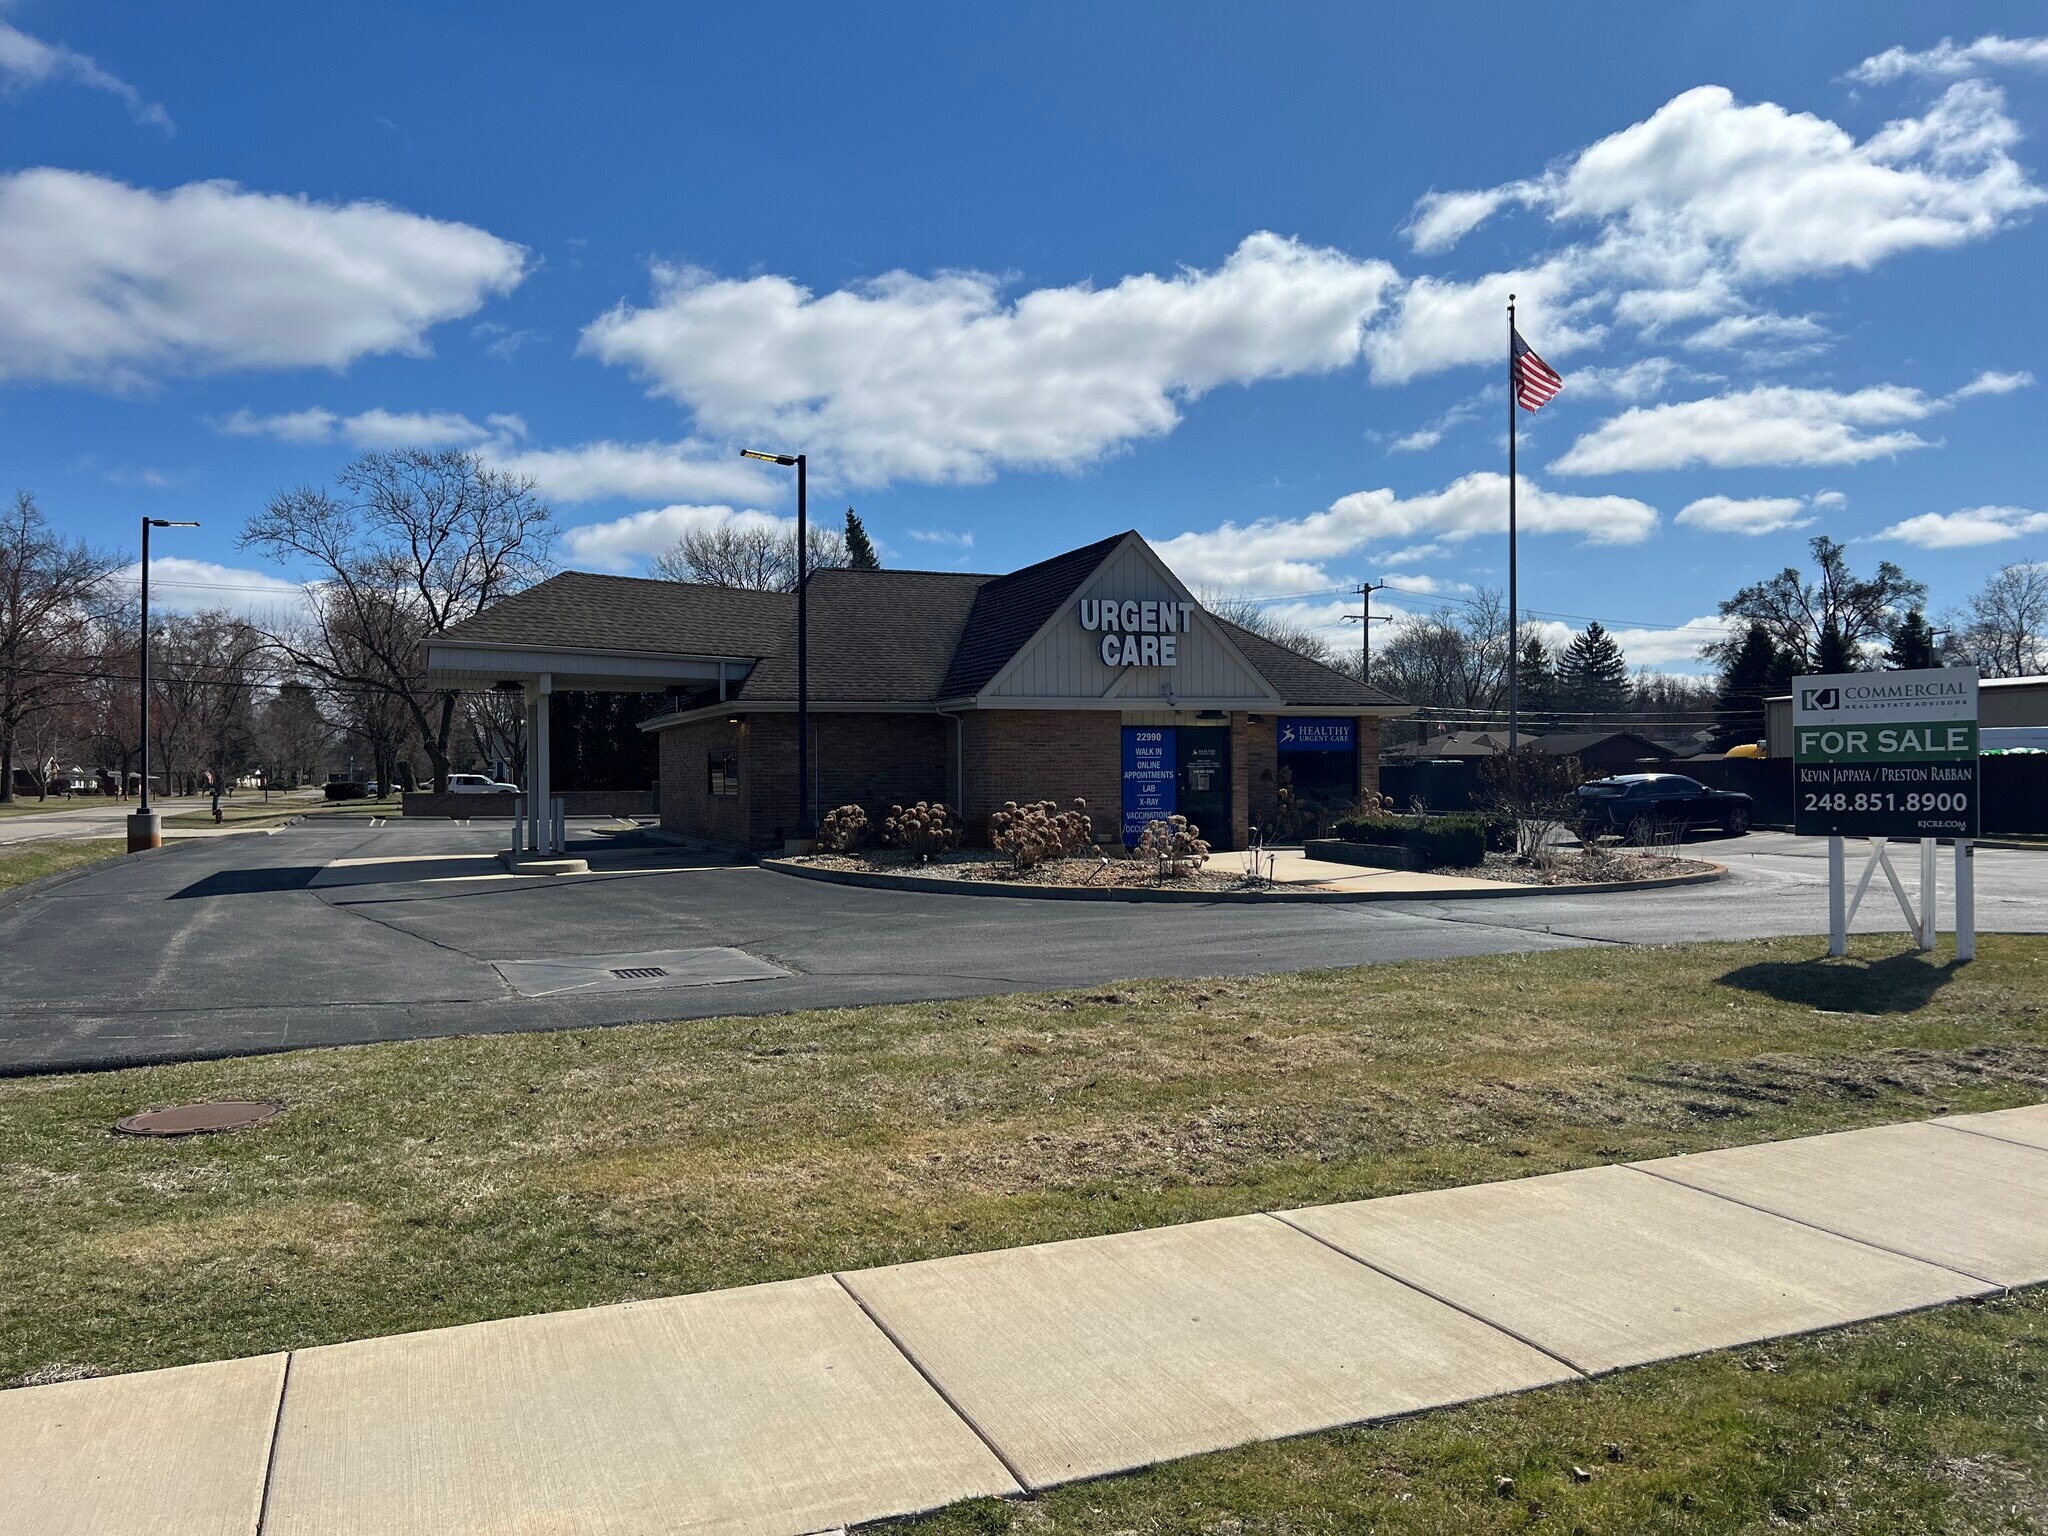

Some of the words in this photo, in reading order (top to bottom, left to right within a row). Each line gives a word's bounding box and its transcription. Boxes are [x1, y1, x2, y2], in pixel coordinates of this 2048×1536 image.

[1081, 599, 1195, 632] URGENT
[1101, 634, 1177, 666] CARE
[1804, 688, 1838, 710] KJ
[1845, 682, 1967, 699] COMMERCIAL
[1299, 726, 1350, 735] HEALTHY
[1136, 733, 1161, 741] 22990
[1801, 731, 1869, 755] FOR
[1878, 727, 1970, 753] SALE
[1135, 748, 1154, 756] WALK
[1137, 761, 1161, 769] ONLINE
[1124, 771, 1174, 779] APPOINTMENTS
[1142, 785, 1156, 793] LAB
[1139, 798, 1159, 806] X-RAY
[1804, 793, 1968, 812] 248.851.8900
[1126, 811, 1173, 819] VACCINATIONS
[1917, 820, 1967, 829] KJCRE.COM
